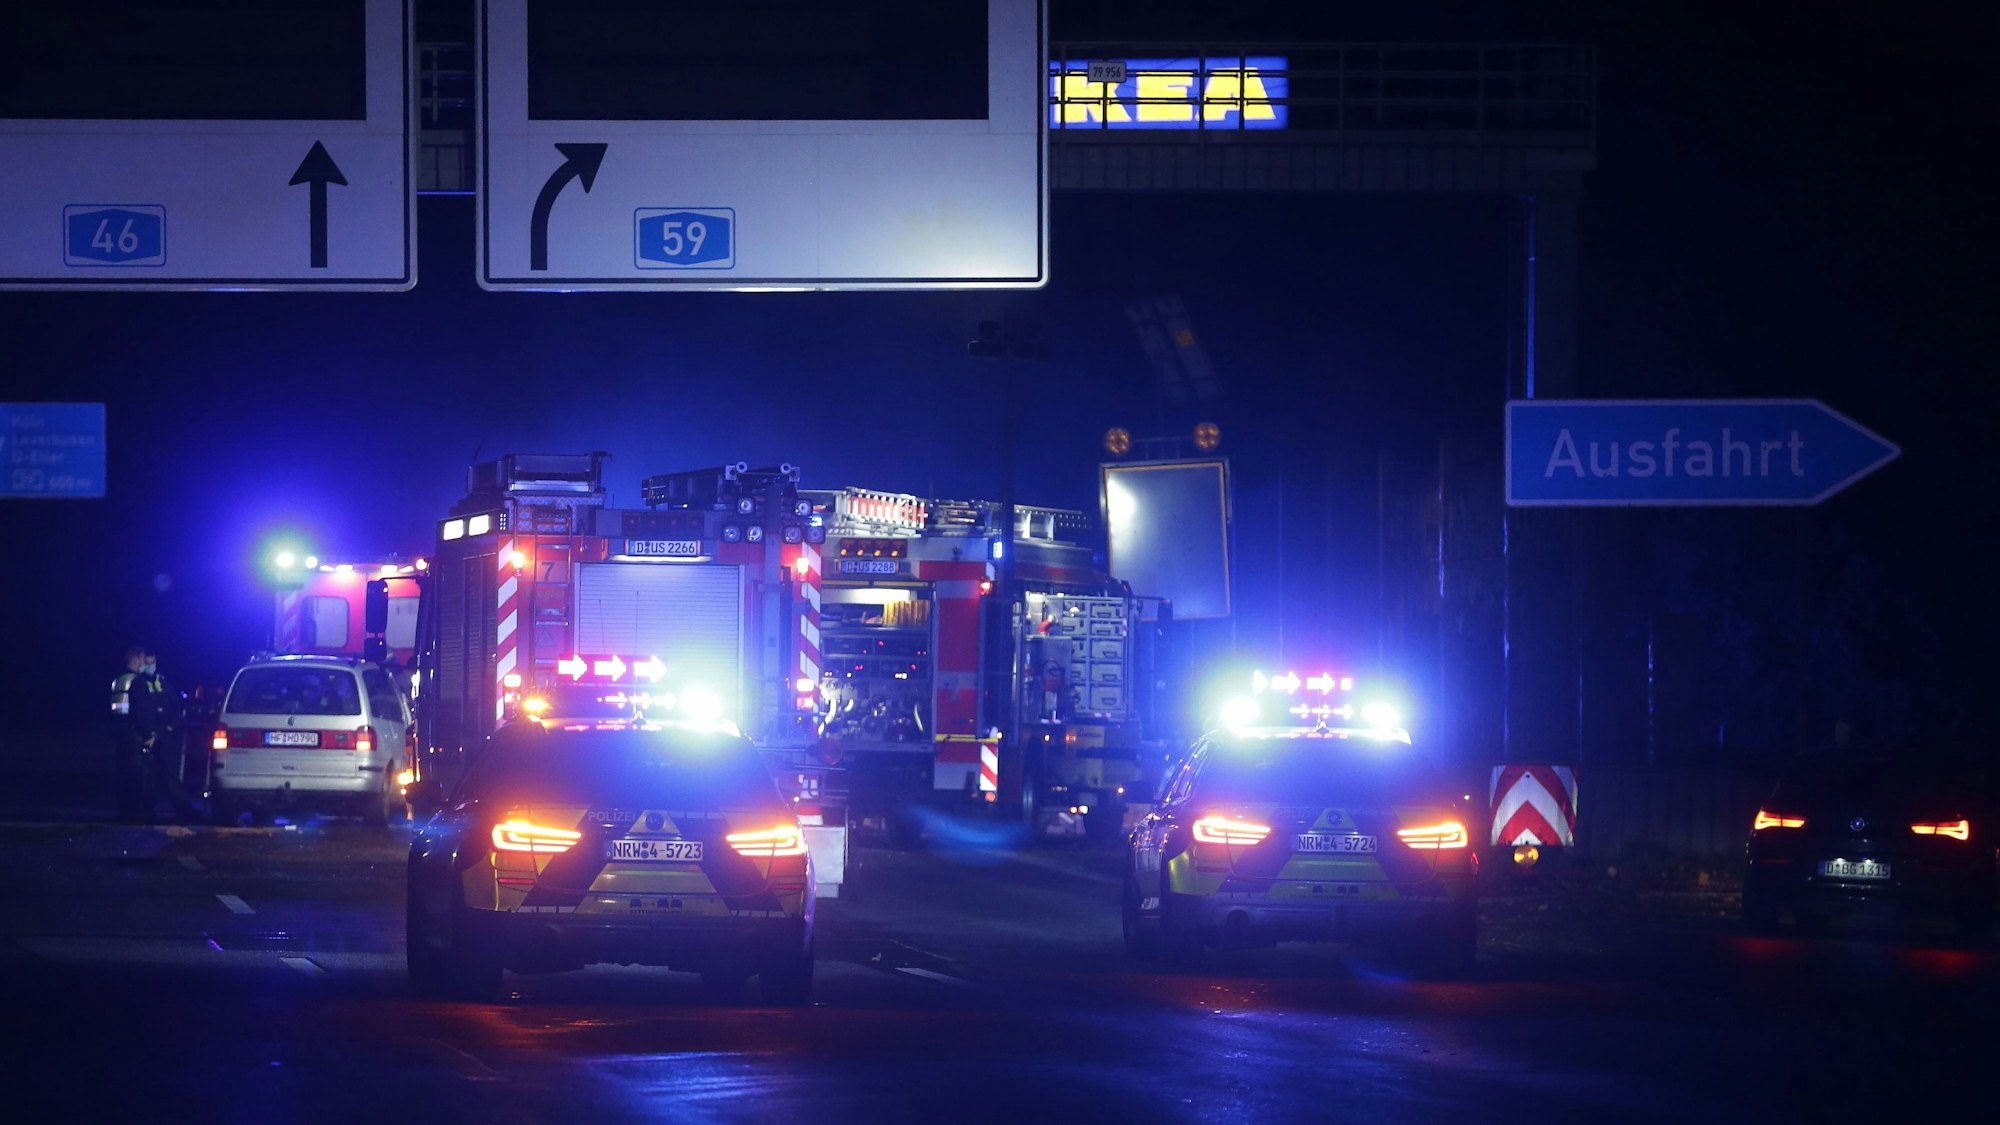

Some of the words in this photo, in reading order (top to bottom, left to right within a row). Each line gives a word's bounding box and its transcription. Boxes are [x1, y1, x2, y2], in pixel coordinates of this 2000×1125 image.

[91, 218, 139, 253] 46
[663, 221, 707, 256] 59
[1544, 427, 1805, 478] Ausfahrt
[636, 542, 644, 553] D
[651, 542, 665, 553] US
[667, 542, 695, 554] 2266
[541, 561, 555, 581] 7
[858, 562, 871, 572] US
[587, 811, 636, 822] POLIZEI
[613, 842, 641, 858] NRW
[649, 843, 702, 859] 4-5723
[1298, 836, 1323, 850] NRW
[1330, 837, 1377, 851] 4-5724
[1827, 863, 1834, 874] D
[1842, 863, 1857, 875] BG
[1859, 865, 1889, 877] 1315
